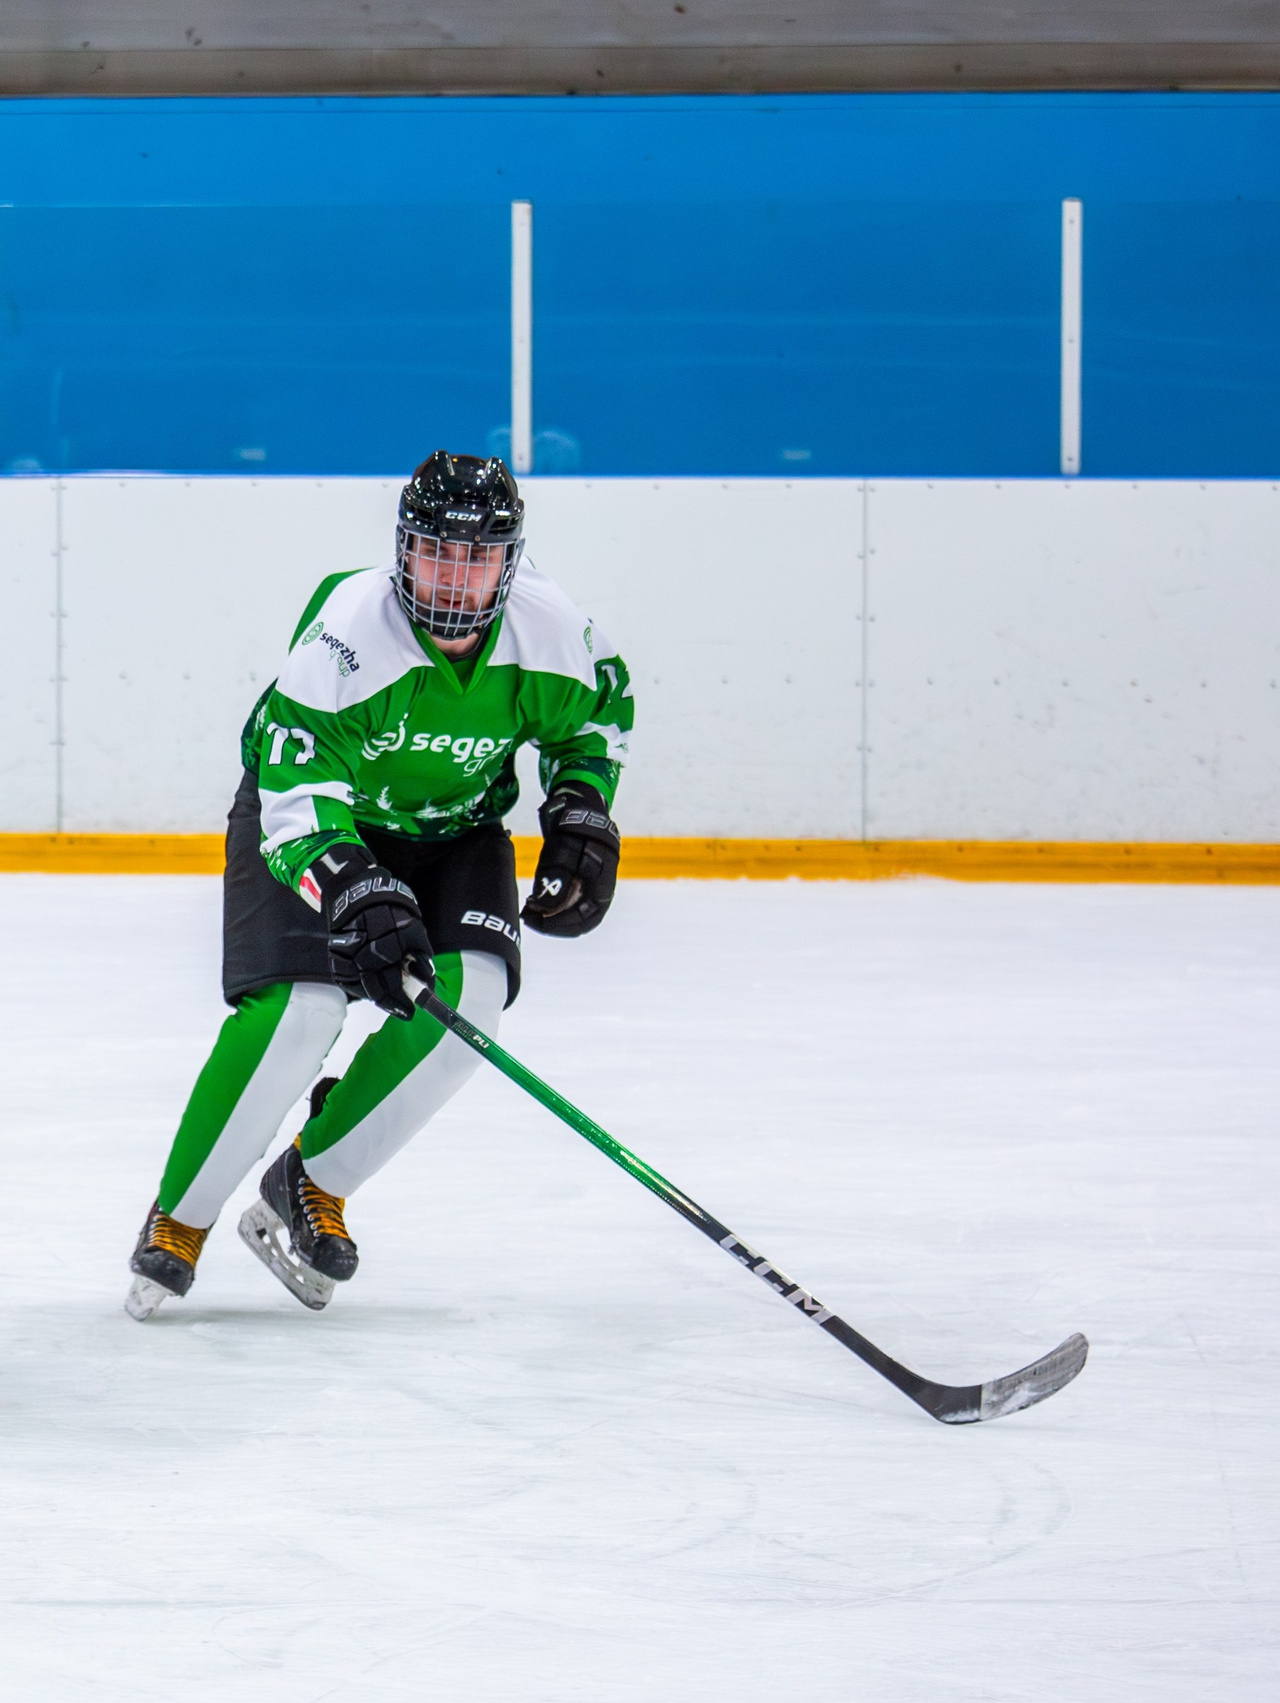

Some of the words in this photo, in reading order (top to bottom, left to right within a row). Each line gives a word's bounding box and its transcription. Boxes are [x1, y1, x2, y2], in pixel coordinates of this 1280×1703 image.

[445, 510, 482, 522] CCM
[319, 632, 360, 673] segezha
[266, 721, 316, 766] 77
[410, 732, 514, 764] segez
[461, 910, 521, 950] Bau
[720, 1234, 836, 1326] CCM
